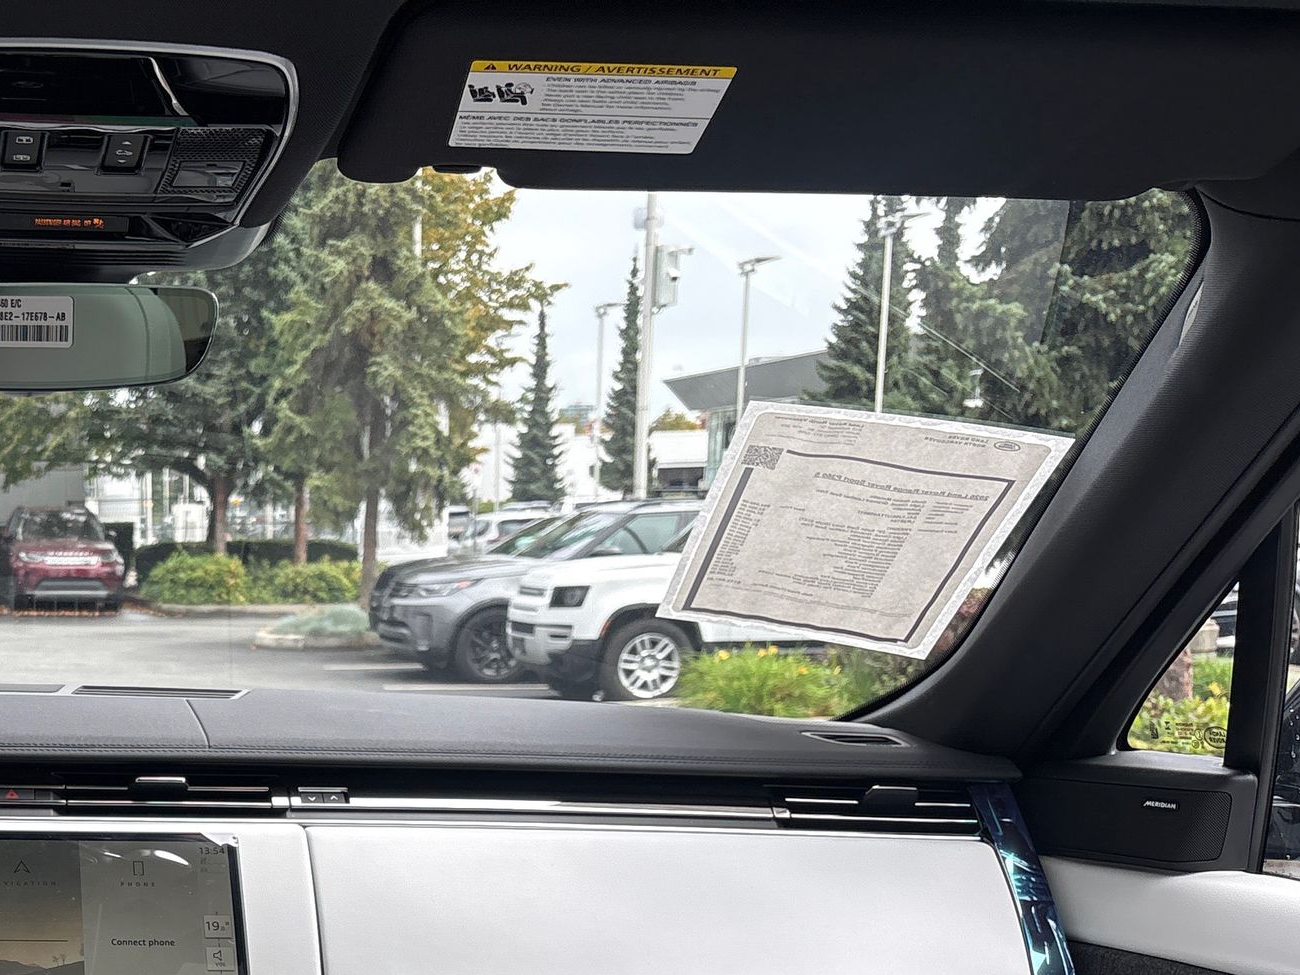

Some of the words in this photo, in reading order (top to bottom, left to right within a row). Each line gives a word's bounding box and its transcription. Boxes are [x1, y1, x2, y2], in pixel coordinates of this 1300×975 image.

[508, 63, 581, 73] WARNING
[595, 65, 721, 76] AVERTISSEMENT
[10, 299, 22, 308] E/C
[1143, 800, 1176, 810] MERIDIAN
[199, 846, 225, 855] 13:54
[111, 938, 146, 947] Connect
[148, 938, 176, 949] phone
